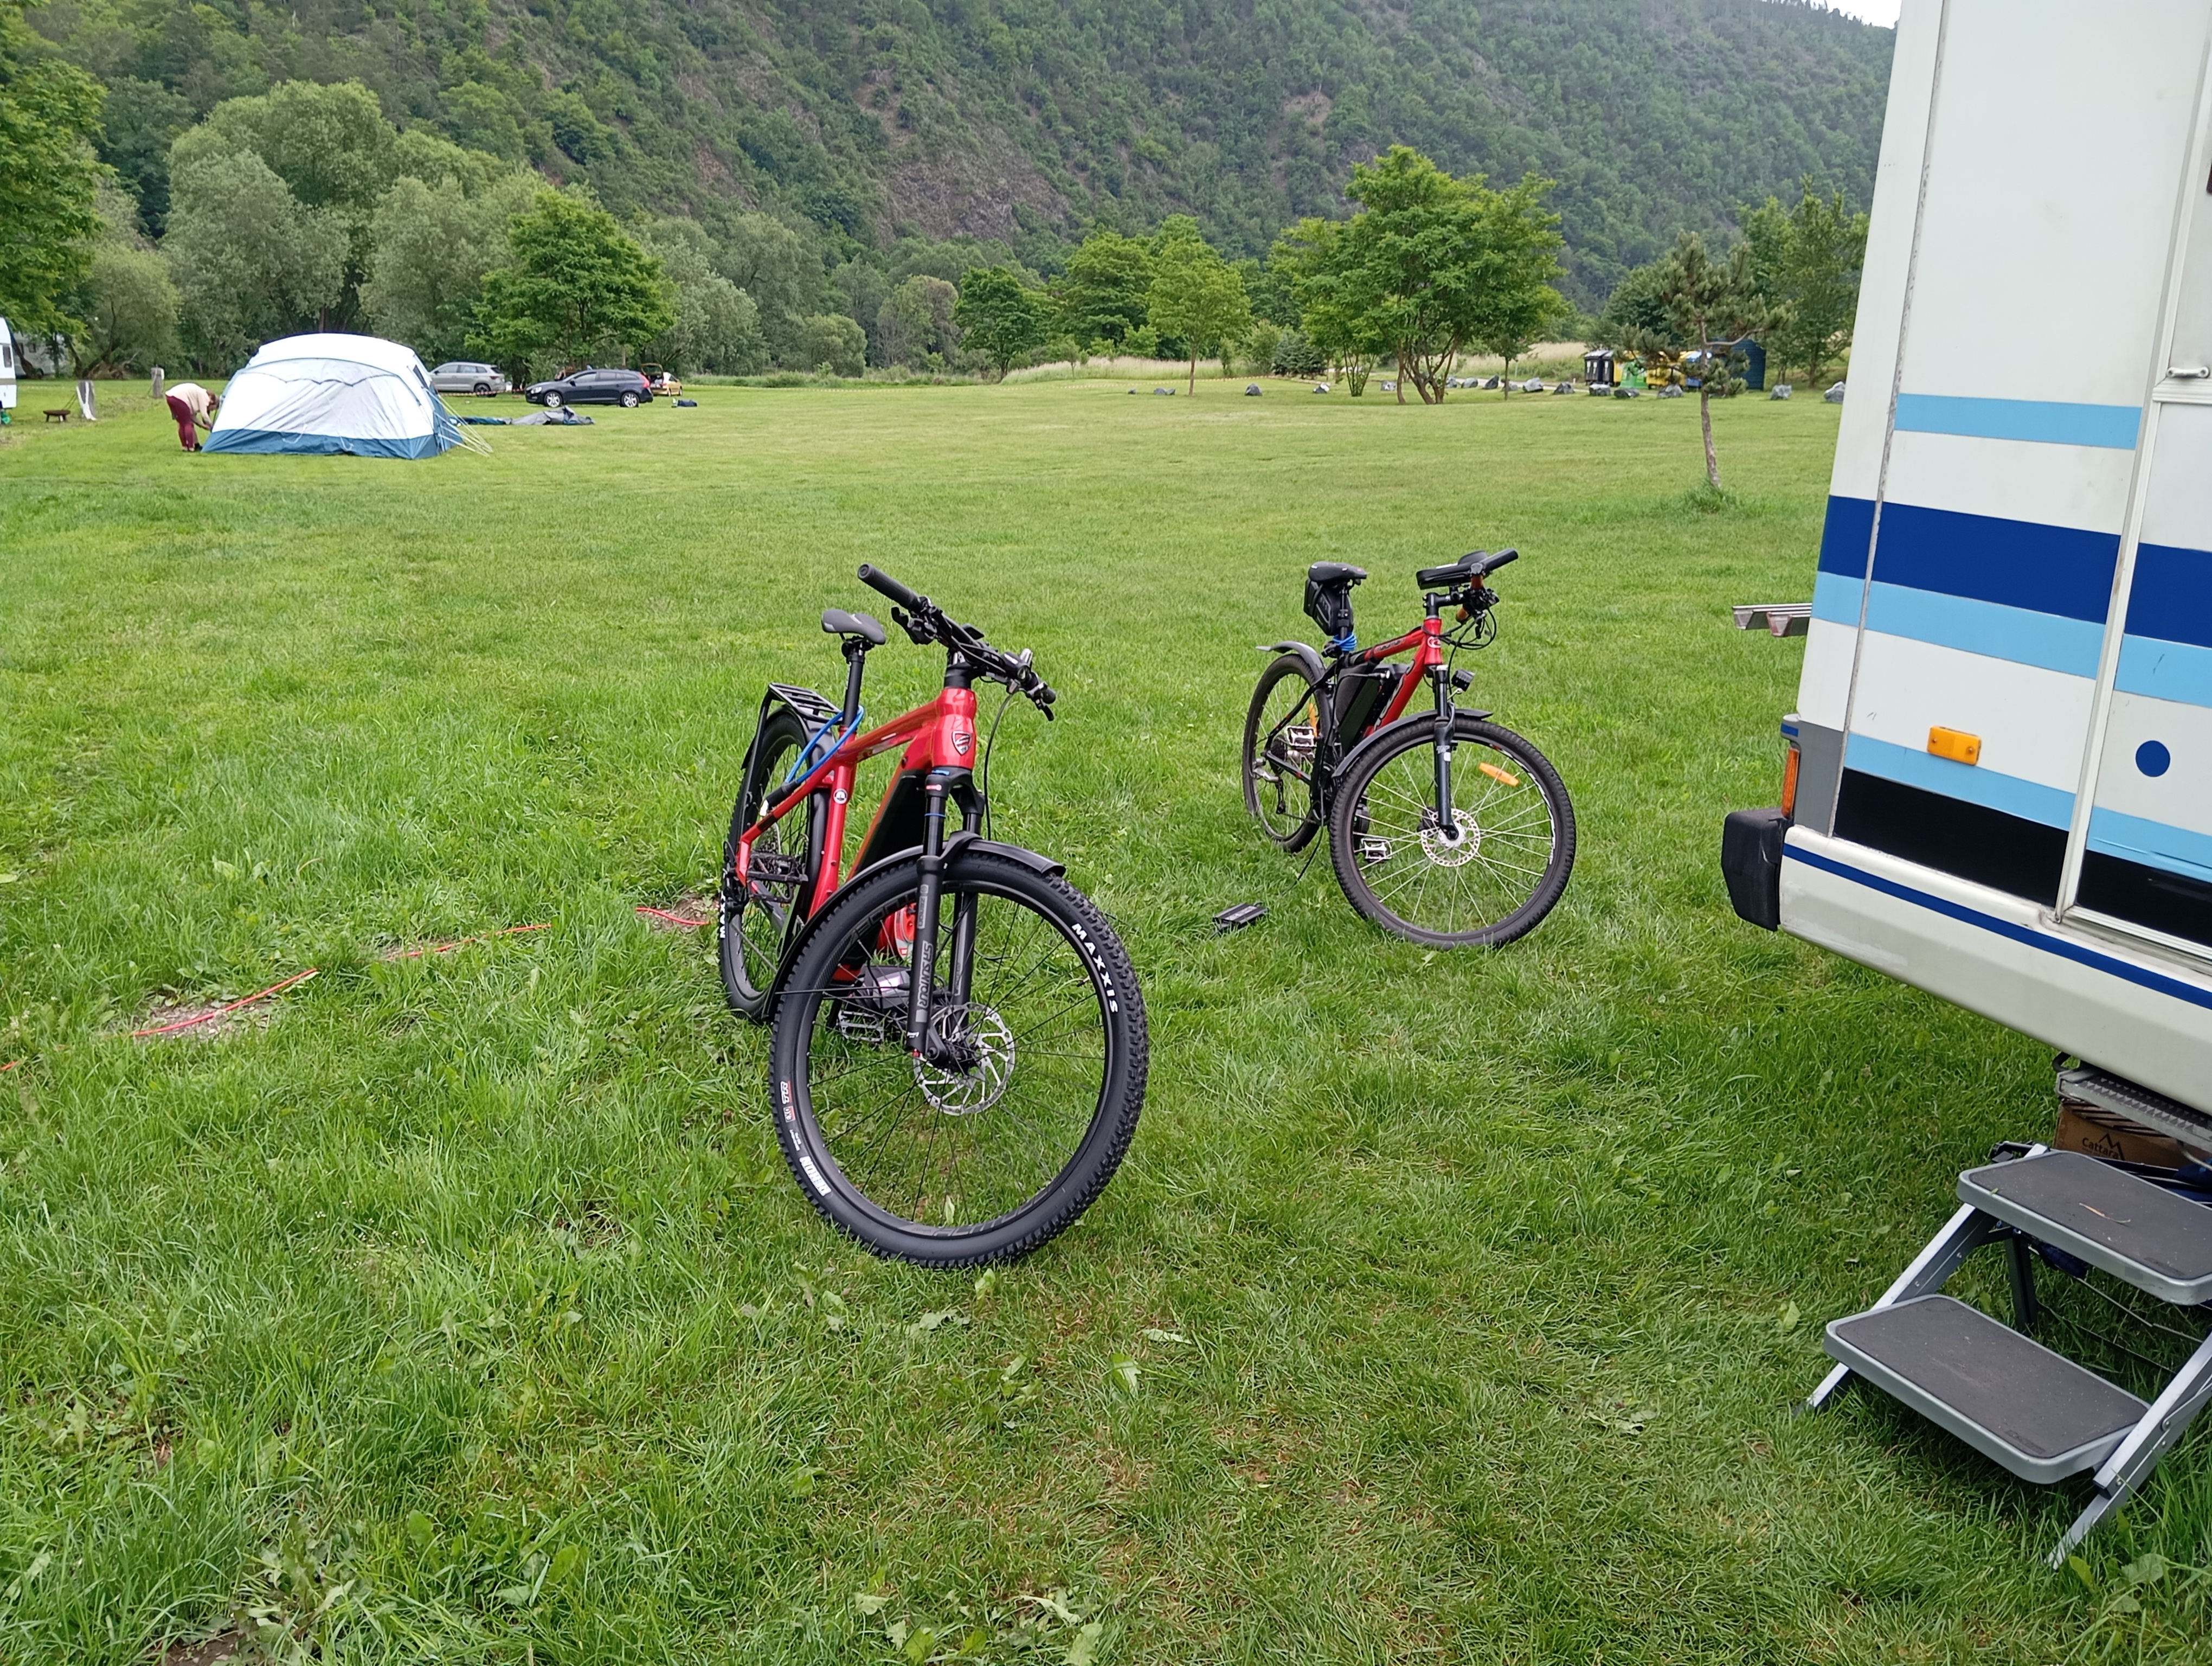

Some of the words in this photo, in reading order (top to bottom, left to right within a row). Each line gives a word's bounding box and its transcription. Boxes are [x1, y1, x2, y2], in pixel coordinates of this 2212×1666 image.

[1071, 923, 1118, 1013] MAXXIS
[2082, 1137, 2119, 1160] Cattara
[799, 1156, 832, 1196] REKON
